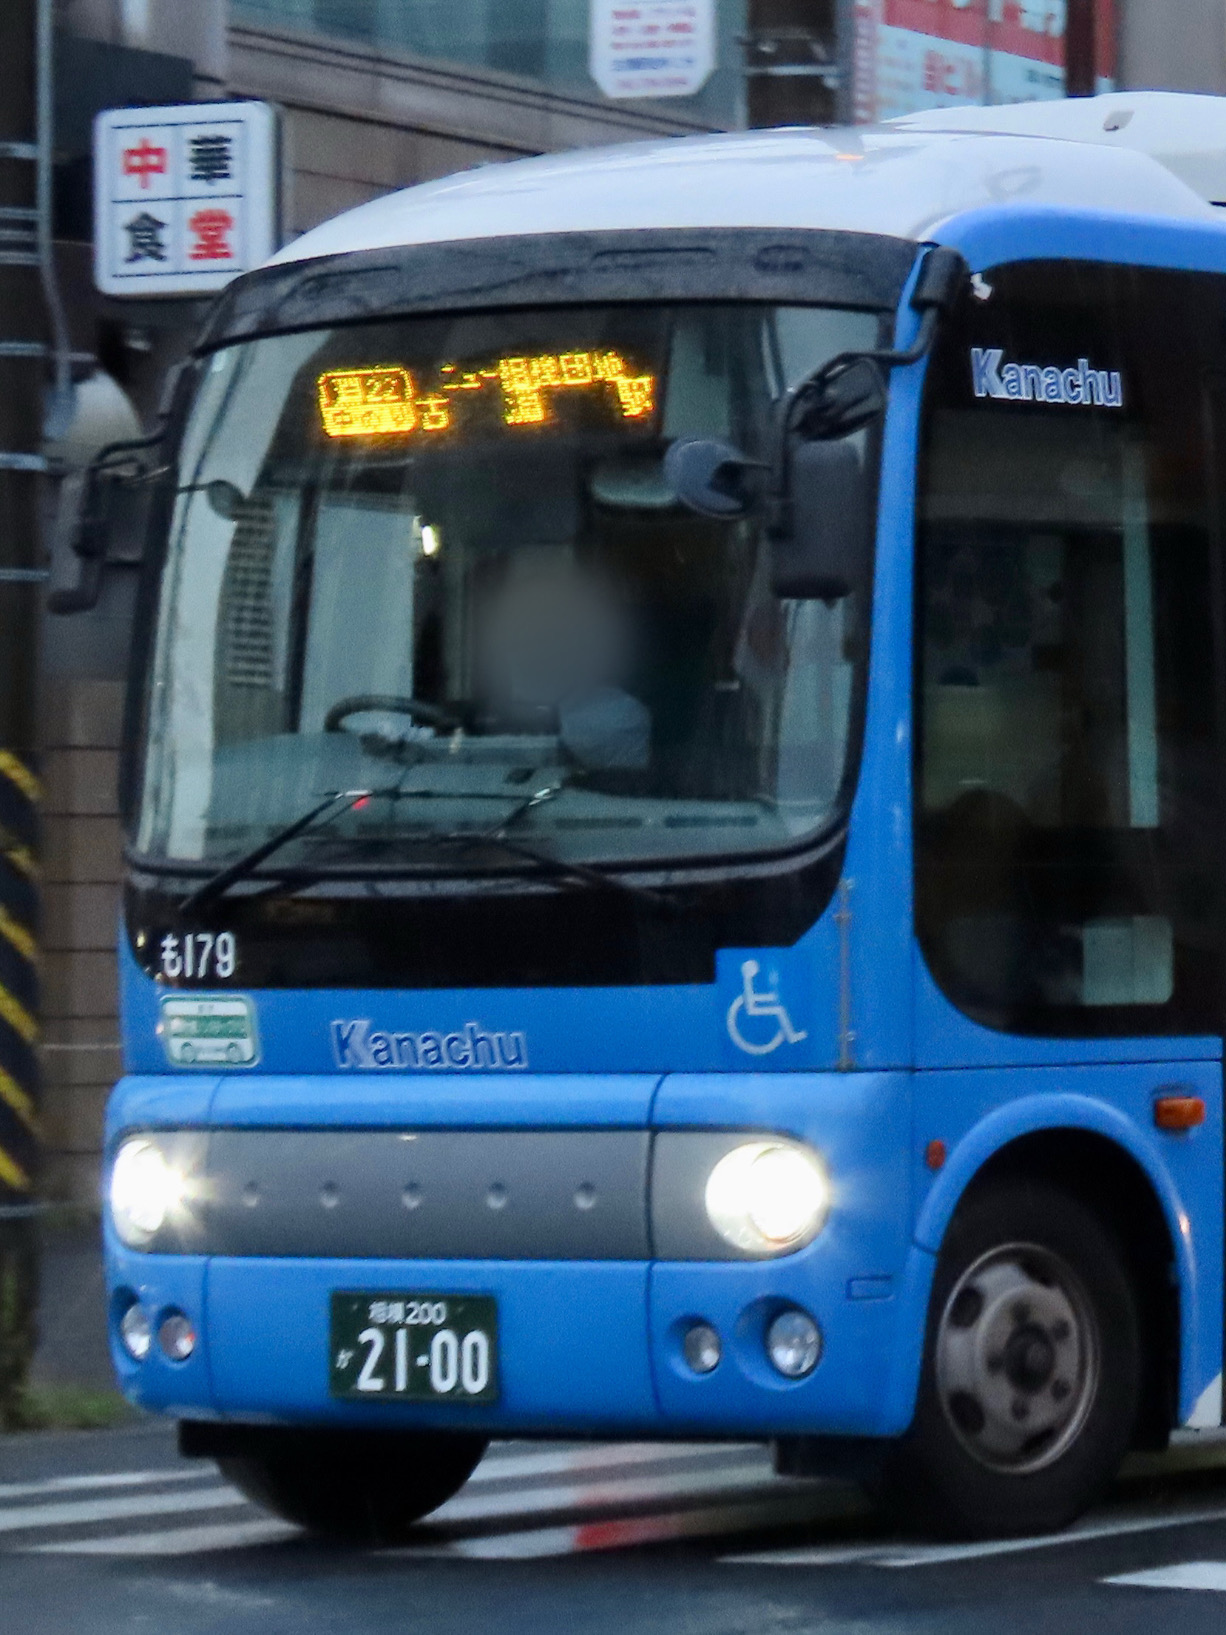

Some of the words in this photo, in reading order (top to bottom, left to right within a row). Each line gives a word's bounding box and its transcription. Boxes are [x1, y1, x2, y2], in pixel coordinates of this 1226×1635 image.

[122, 136, 233, 187] 中華
[123, 208, 234, 263] 食堂
[970, 347, 1123, 408] Kanachu
[160, 931, 237, 979] も179
[329, 1018, 530, 1069] Kanachu
[356, 1327, 490, 1395] 21-00
